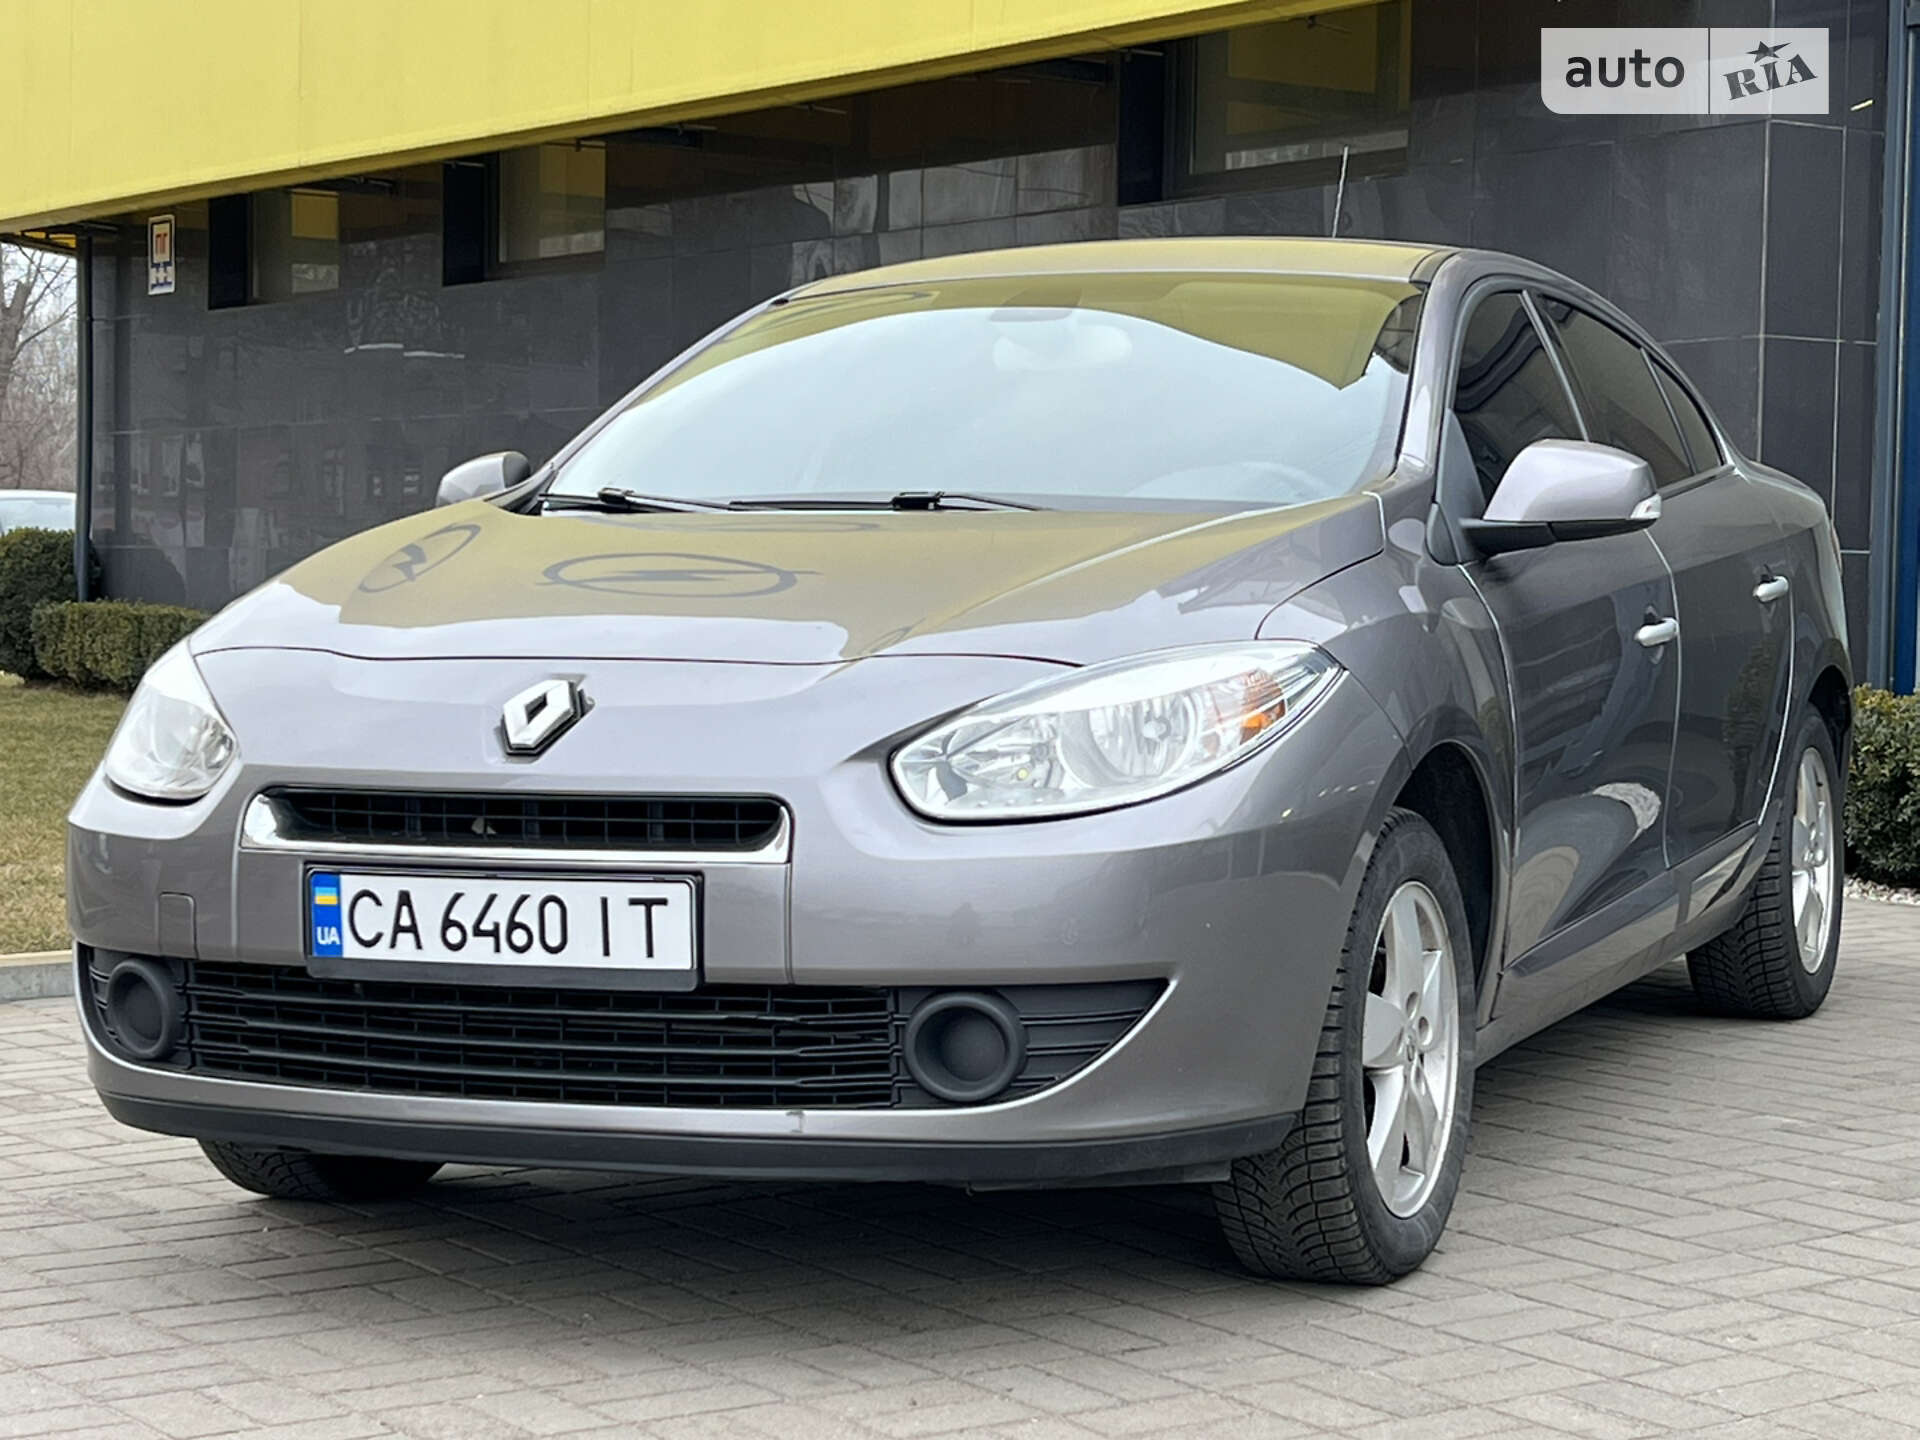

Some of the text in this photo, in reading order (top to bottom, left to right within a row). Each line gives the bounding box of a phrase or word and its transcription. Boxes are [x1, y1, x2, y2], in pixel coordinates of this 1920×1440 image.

[316, 926, 340, 946] UA
[348, 888, 668, 958] CA 6460 IT
